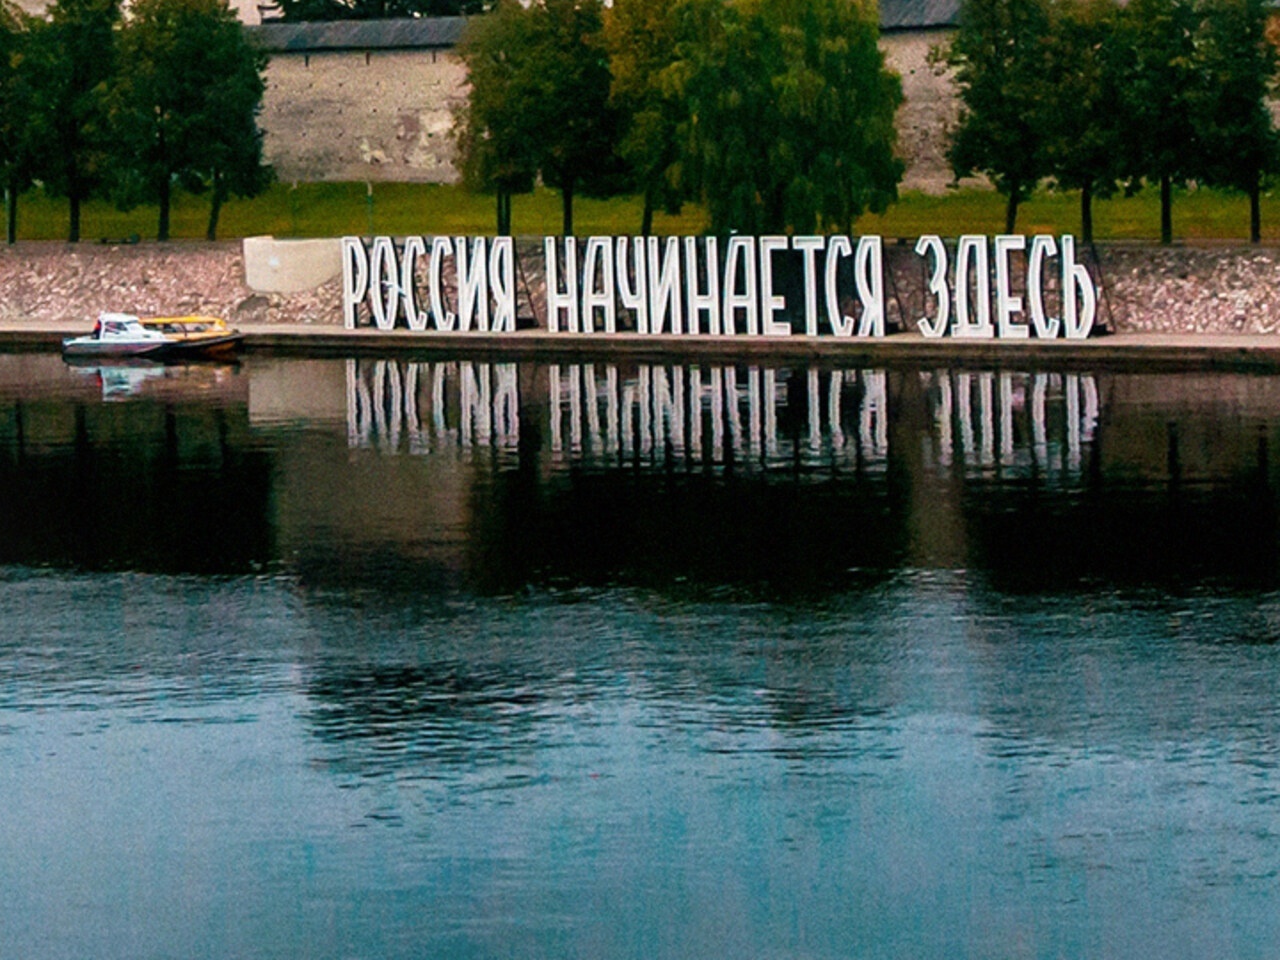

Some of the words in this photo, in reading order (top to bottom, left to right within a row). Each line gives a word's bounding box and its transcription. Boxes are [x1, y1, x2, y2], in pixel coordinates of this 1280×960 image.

[341, 236, 517, 332] РОССИЯ
[545, 235, 887, 337] НАЧИНАЕТСЯ
[915, 235, 1098, 340] ЗДЕСЬ
